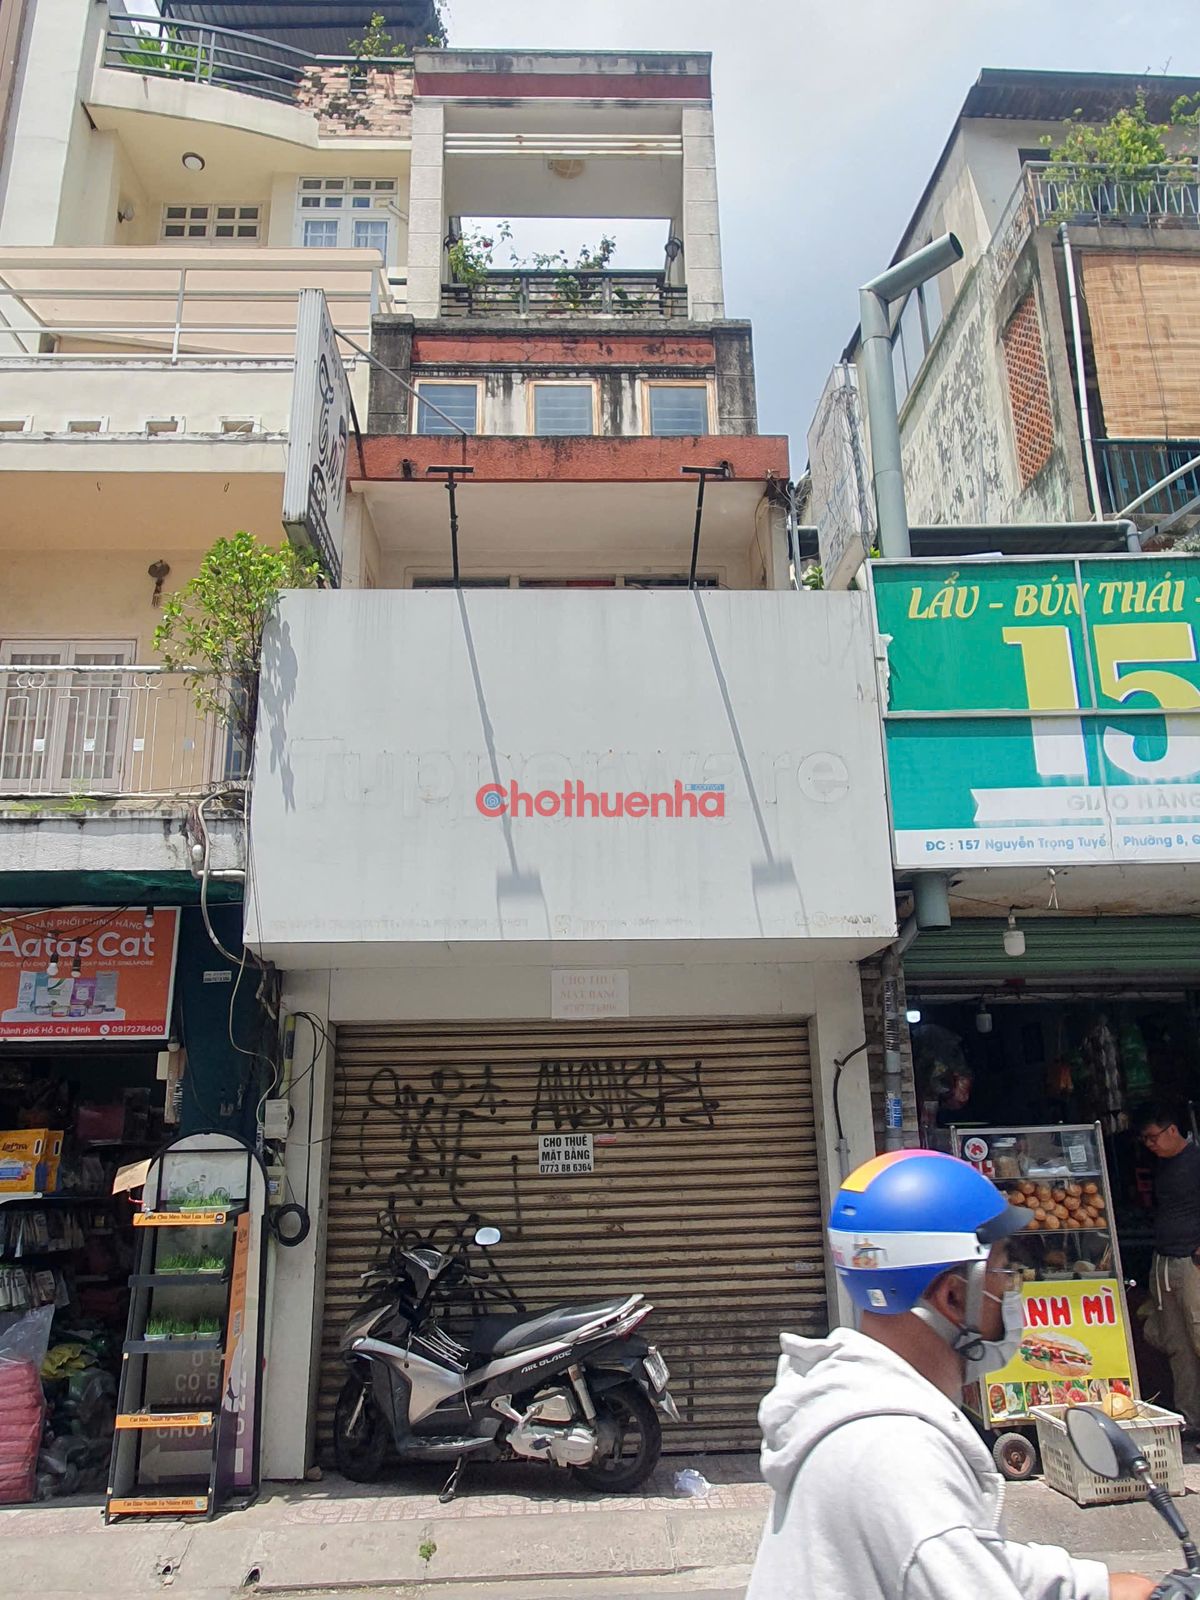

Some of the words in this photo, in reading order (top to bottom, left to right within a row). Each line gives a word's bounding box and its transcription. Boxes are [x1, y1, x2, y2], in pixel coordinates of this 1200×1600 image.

[1014, 575, 1089, 617] BÚN
[1099, 572, 1185, 615] THÁI
[925, 840, 946, 851] ĐC
[958, 840, 980, 850] 157
[985, 836, 1035, 852] Nguyễn
[1038, 837, 1074, 851] Trọng
[1078, 833, 1119, 849] Tuyể
[1123, 834, 1172, 848] Phường
[71, 1025, 91, 1034] Minh
[543, 1137, 562, 1147] CHO
[565, 1134, 588, 1147] THUÊ
[540, 1163, 559, 1173] 0773
[1022, 1296, 1072, 1328] NH
[1082, 1286, 1117, 1327] MÌ
